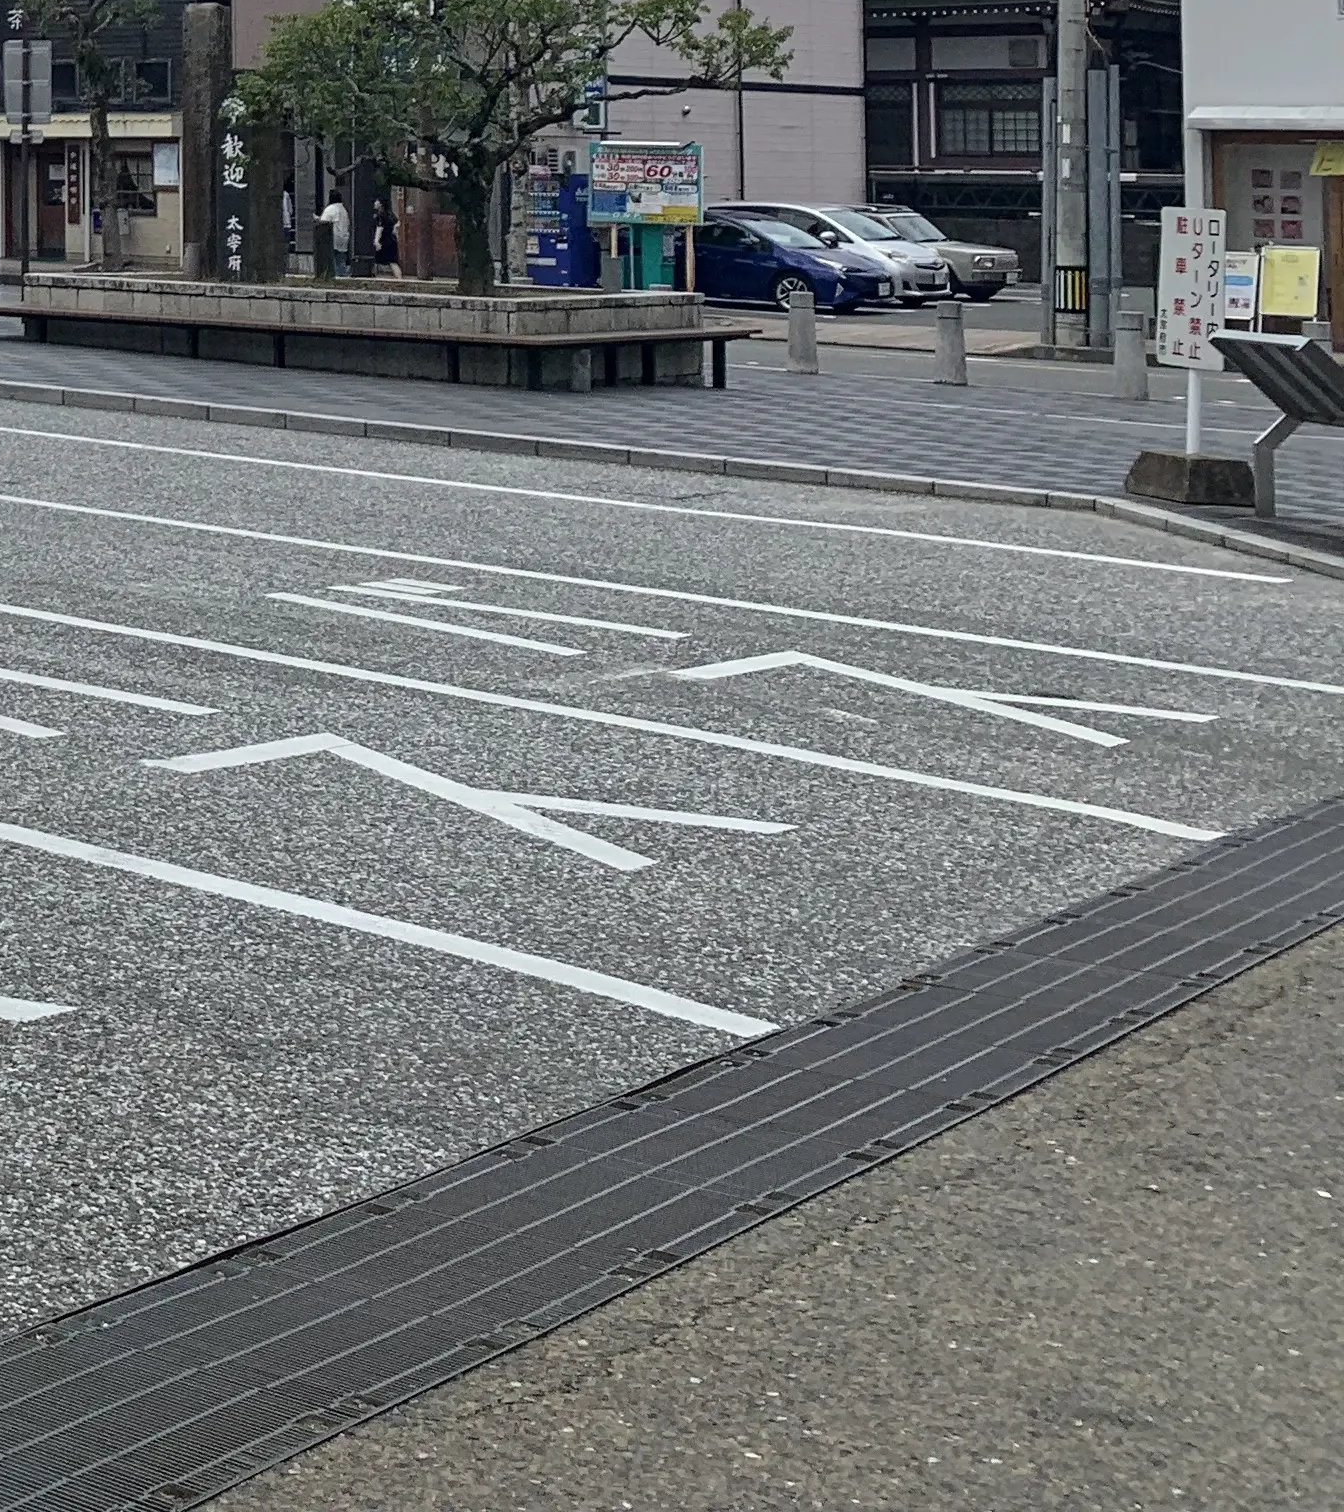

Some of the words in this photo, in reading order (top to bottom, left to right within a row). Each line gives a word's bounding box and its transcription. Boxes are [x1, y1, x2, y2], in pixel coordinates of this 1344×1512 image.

[226, 215, 244, 271] 太宰府
[1172, 216, 1188, 356] 駐車禁止
[1188, 217, 1203, 360] Uターン禁止
